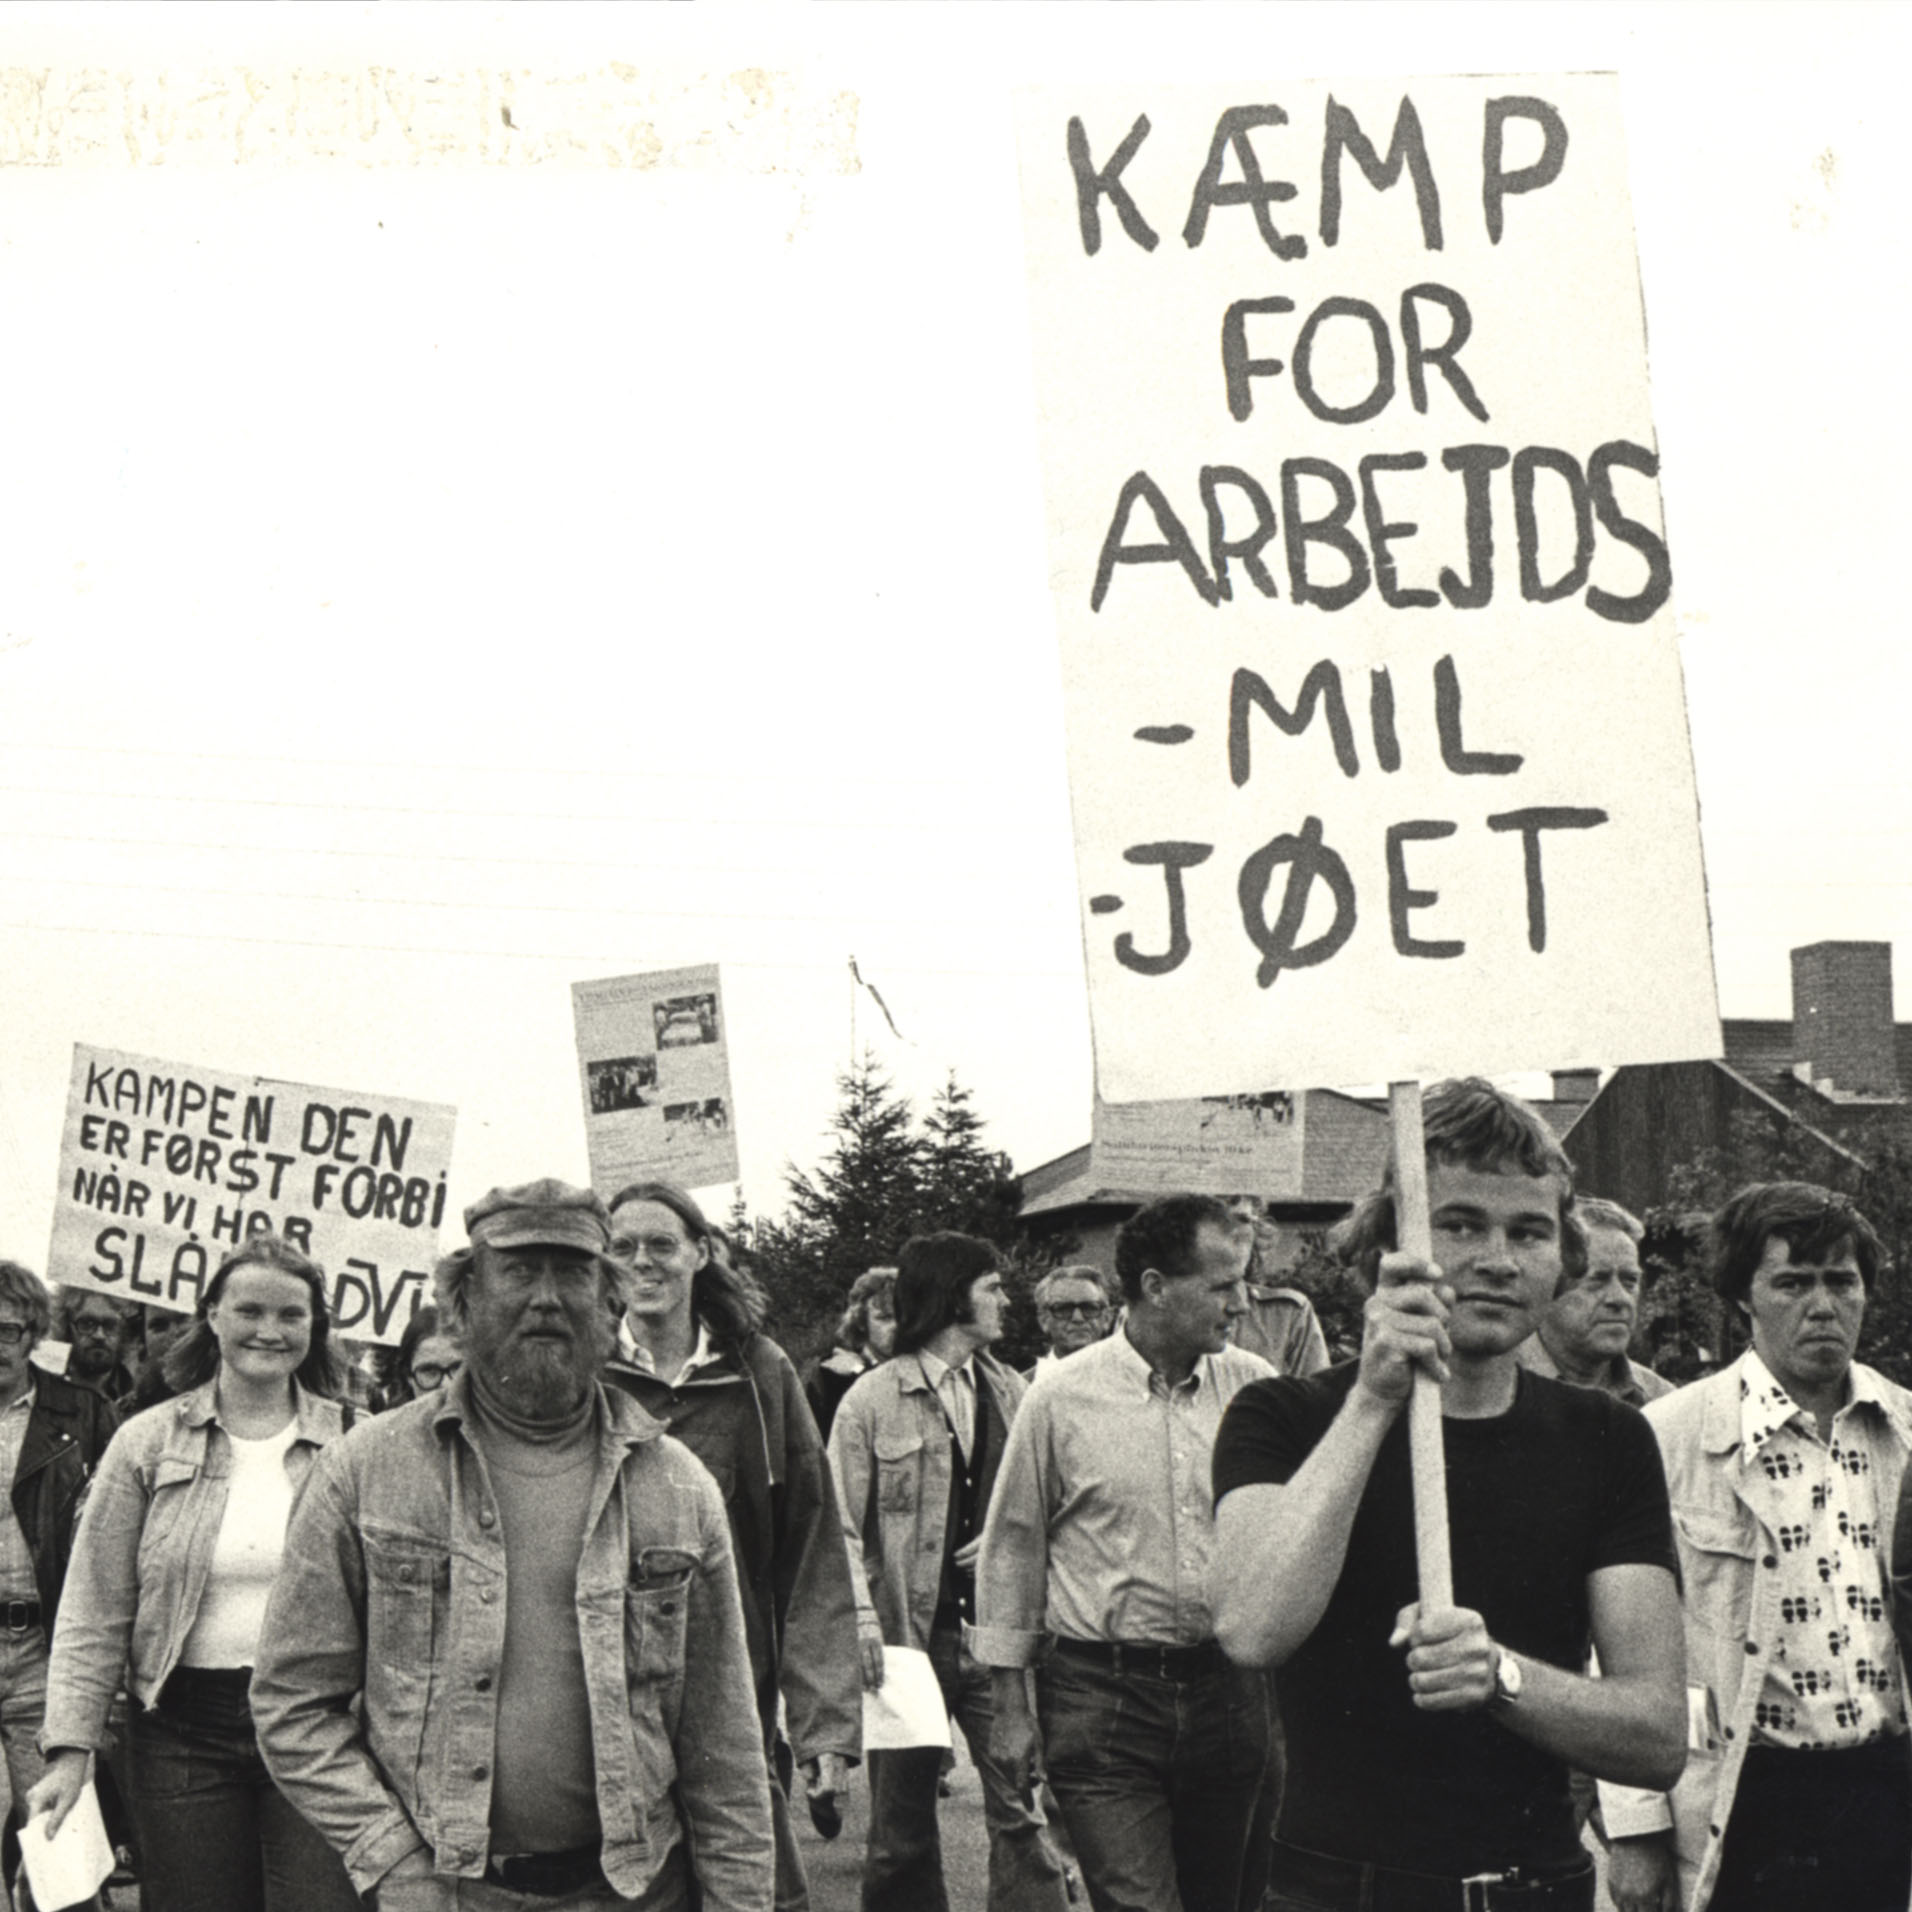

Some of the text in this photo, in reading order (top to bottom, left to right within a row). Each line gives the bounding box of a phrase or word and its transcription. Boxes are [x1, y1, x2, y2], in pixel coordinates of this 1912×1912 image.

[1066, 93, 1570, 263] KÆMP
[1220, 281, 1491, 426] FOR
[1089, 438, 1674, 626] ARBEJDS
[78, 1113, 131, 1160] ER
[140, 1128, 297, 1201] FØRST
[83, 1060, 414, 1173] KAMPEN DEN
[72, 1163, 152, 1219] NÅR
[163, 1190, 198, 1231] VI
